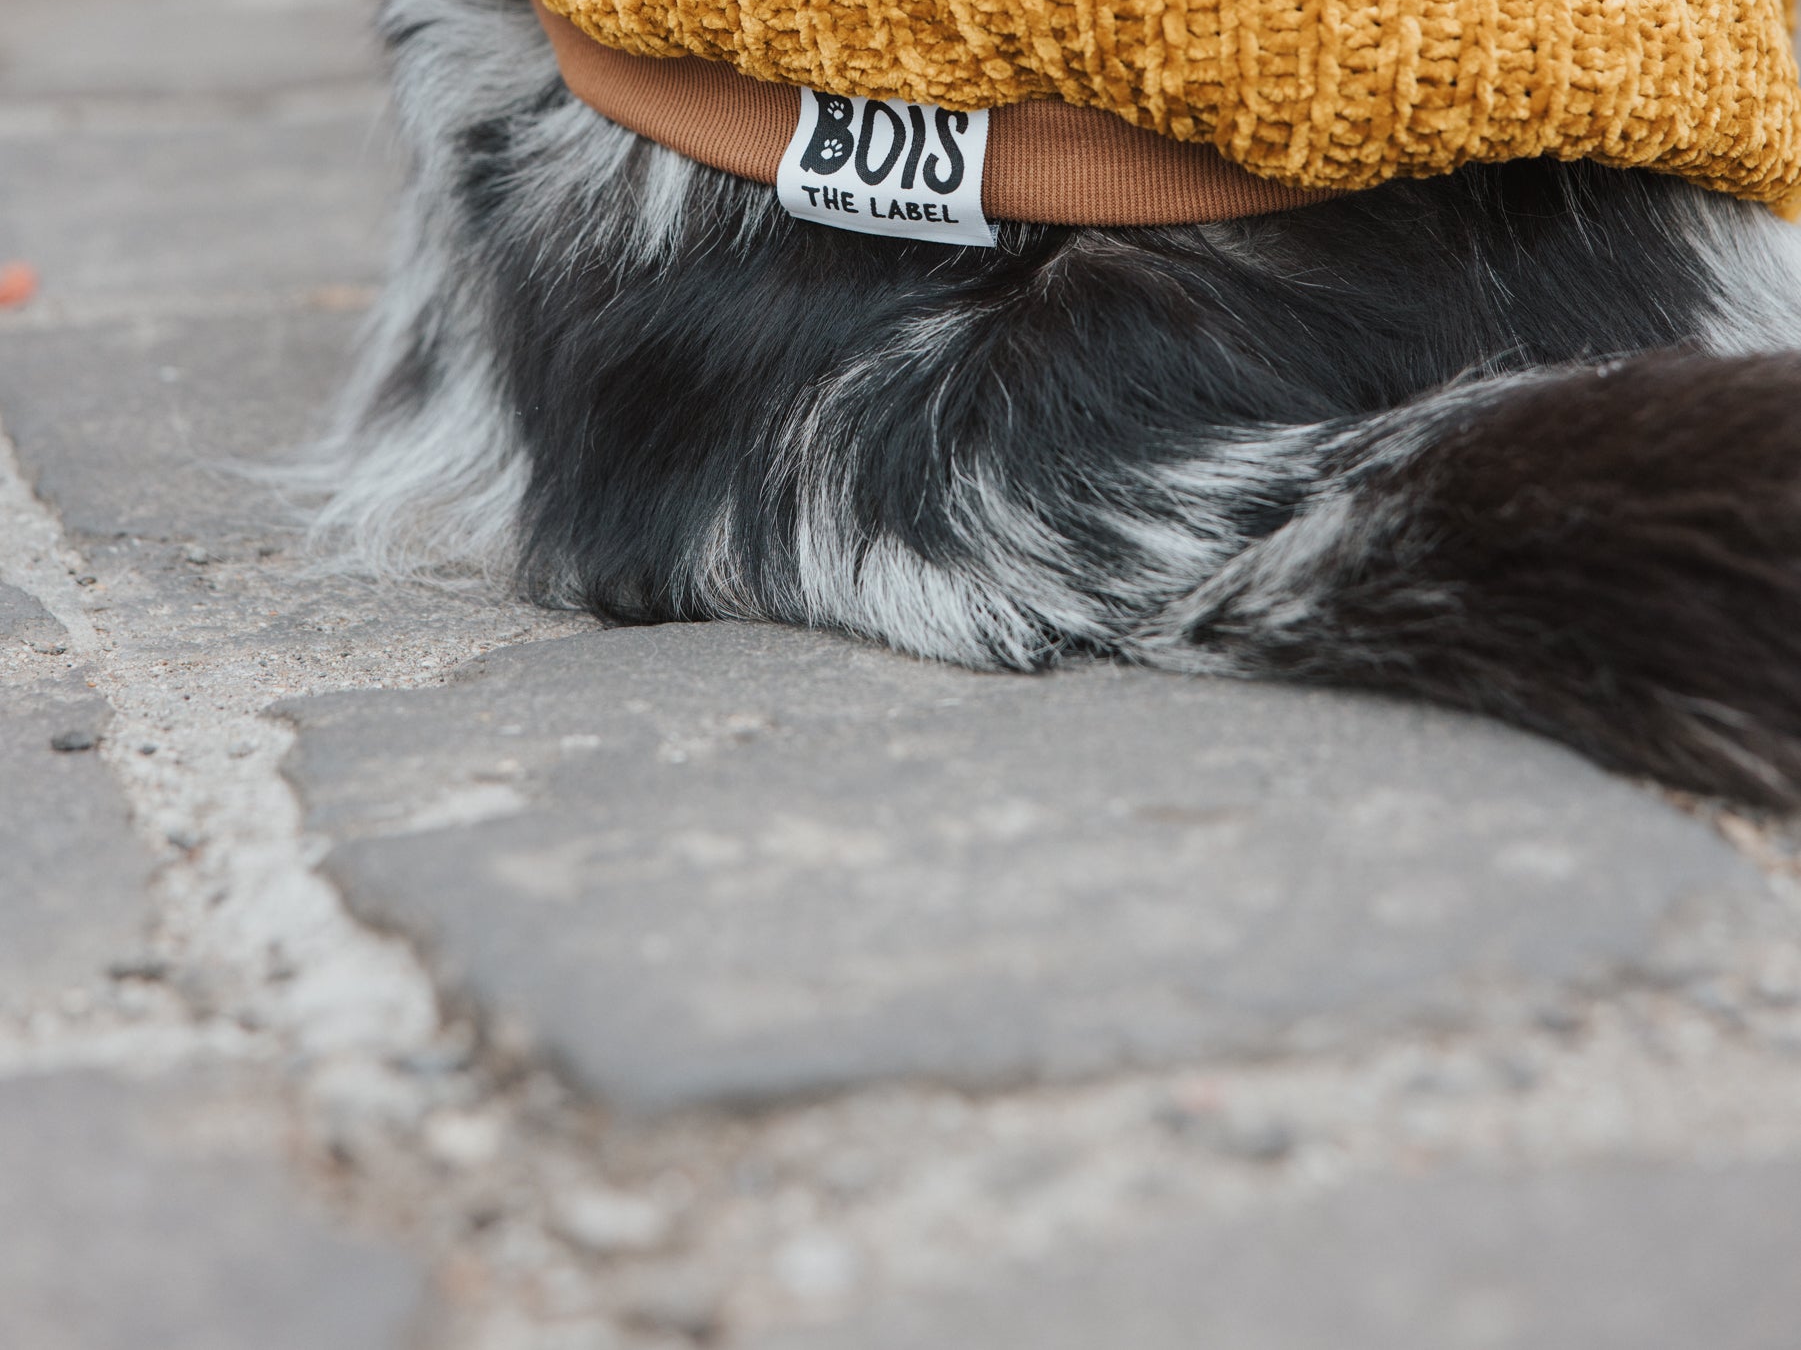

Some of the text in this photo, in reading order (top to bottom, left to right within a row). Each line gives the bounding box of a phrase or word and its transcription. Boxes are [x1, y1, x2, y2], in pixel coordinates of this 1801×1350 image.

[800, 90, 968, 195] BOIS
[801, 185, 959, 224] THE LABEL
